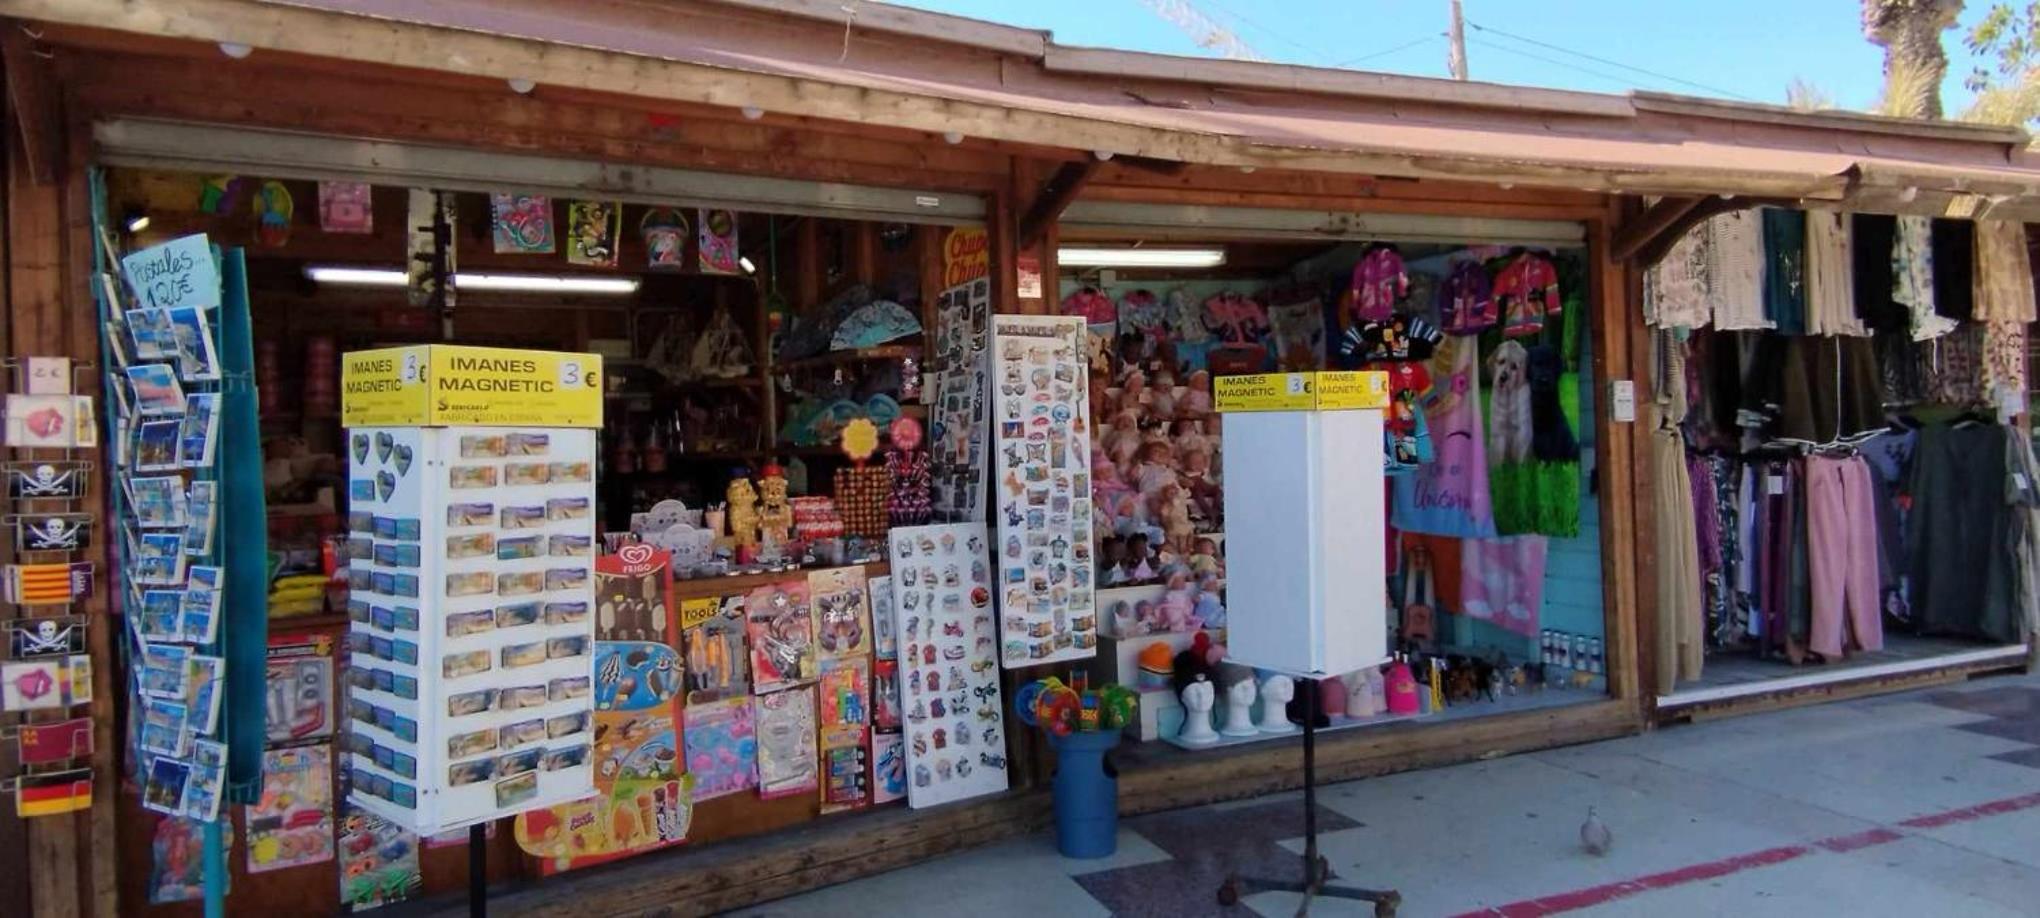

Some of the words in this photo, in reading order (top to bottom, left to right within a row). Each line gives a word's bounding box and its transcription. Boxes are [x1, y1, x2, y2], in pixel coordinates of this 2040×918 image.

[352, 360, 393, 375] IMANES
[450, 357, 536, 374] IMANES
[1223, 376, 1267, 386] IMANES
[1322, 373, 1356, 381] IMANES
[346, 378, 402, 394] MAGNETIC
[438, 377, 555, 393] MAGNETIC
[1319, 384, 1362, 394] MAGNETIC
[1217, 387, 1276, 398] MAGNETIC
[623, 563, 652, 574] FRIGO
[684, 608, 718, 619] TOOLS
